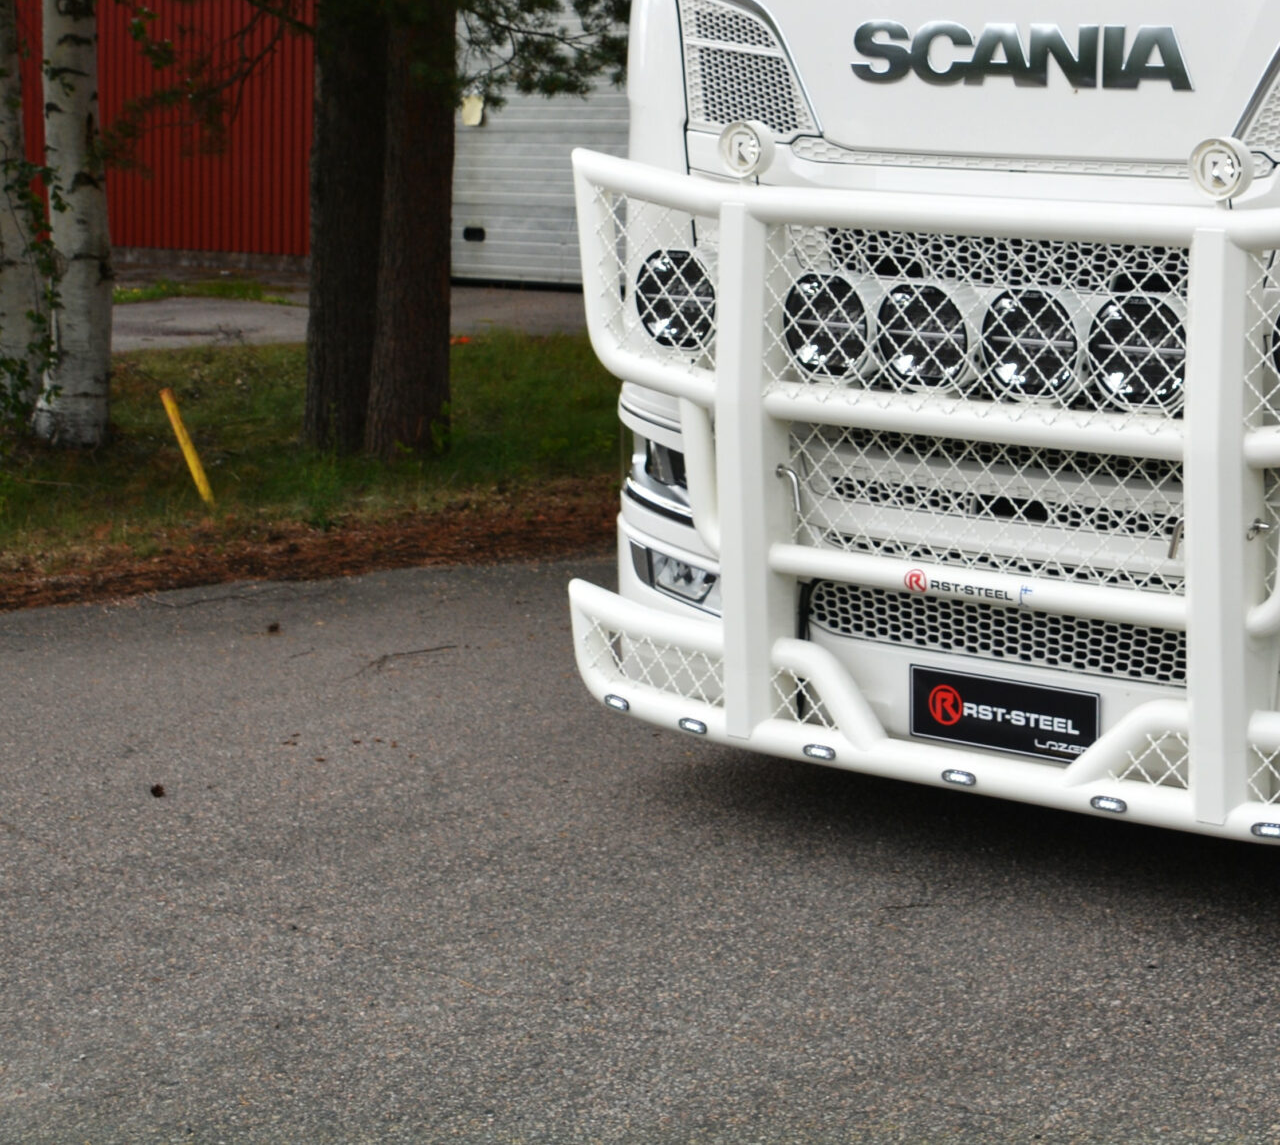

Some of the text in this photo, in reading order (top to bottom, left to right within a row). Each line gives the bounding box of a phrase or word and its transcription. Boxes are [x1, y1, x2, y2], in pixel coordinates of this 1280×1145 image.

[850, 19, 1195, 92] SCANIA
[929, 578, 1014, 602] RST-STEEL
[962, 701, 1081, 736] RST-STEEL
